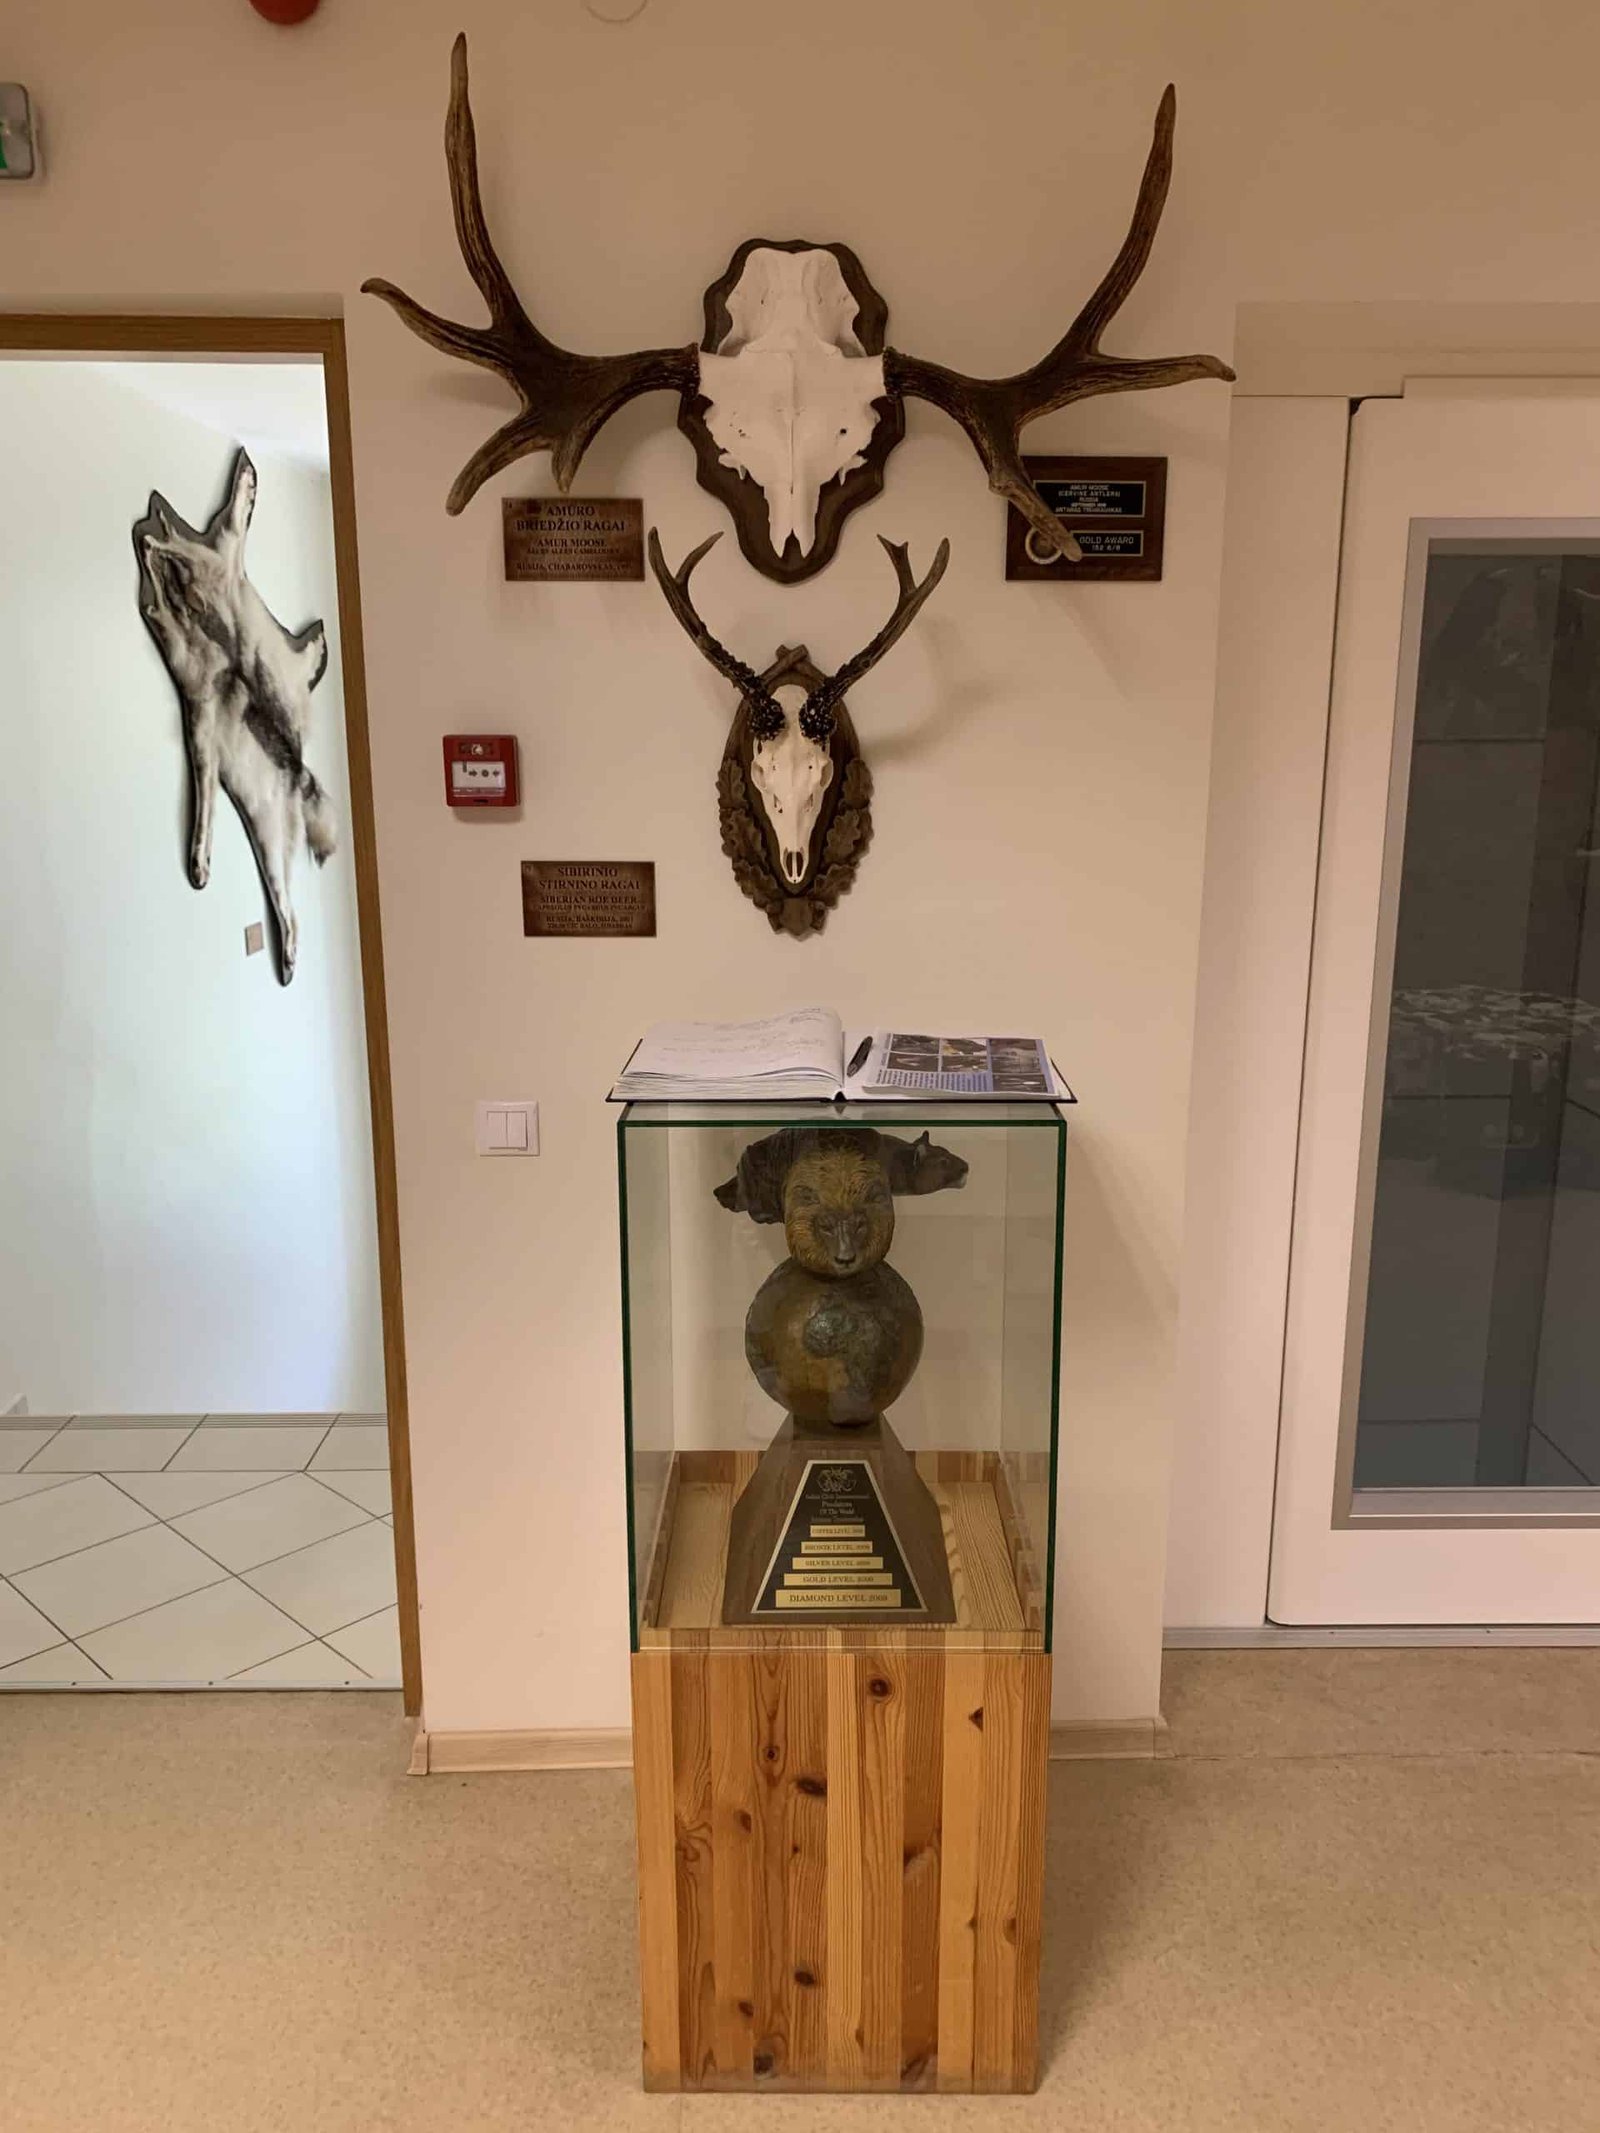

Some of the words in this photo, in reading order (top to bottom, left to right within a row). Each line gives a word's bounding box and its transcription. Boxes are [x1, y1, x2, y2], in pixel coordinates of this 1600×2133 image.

[547, 505, 596, 517] AMURO
[516, 518, 581, 532] BRIEDŽIO
[584, 519, 626, 532] RAGAI
[538, 538, 568, 548] AMUR
[1079, 536, 1102, 545] GOLD
[557, 866, 618, 878] SIBIRINIO
[538, 879, 598, 891] STIRNINO
[601, 879, 640, 890] RAGAI
[789, 1594, 834, 1603] DIAMOND
[836, 1594, 867, 1603] LEVEL
